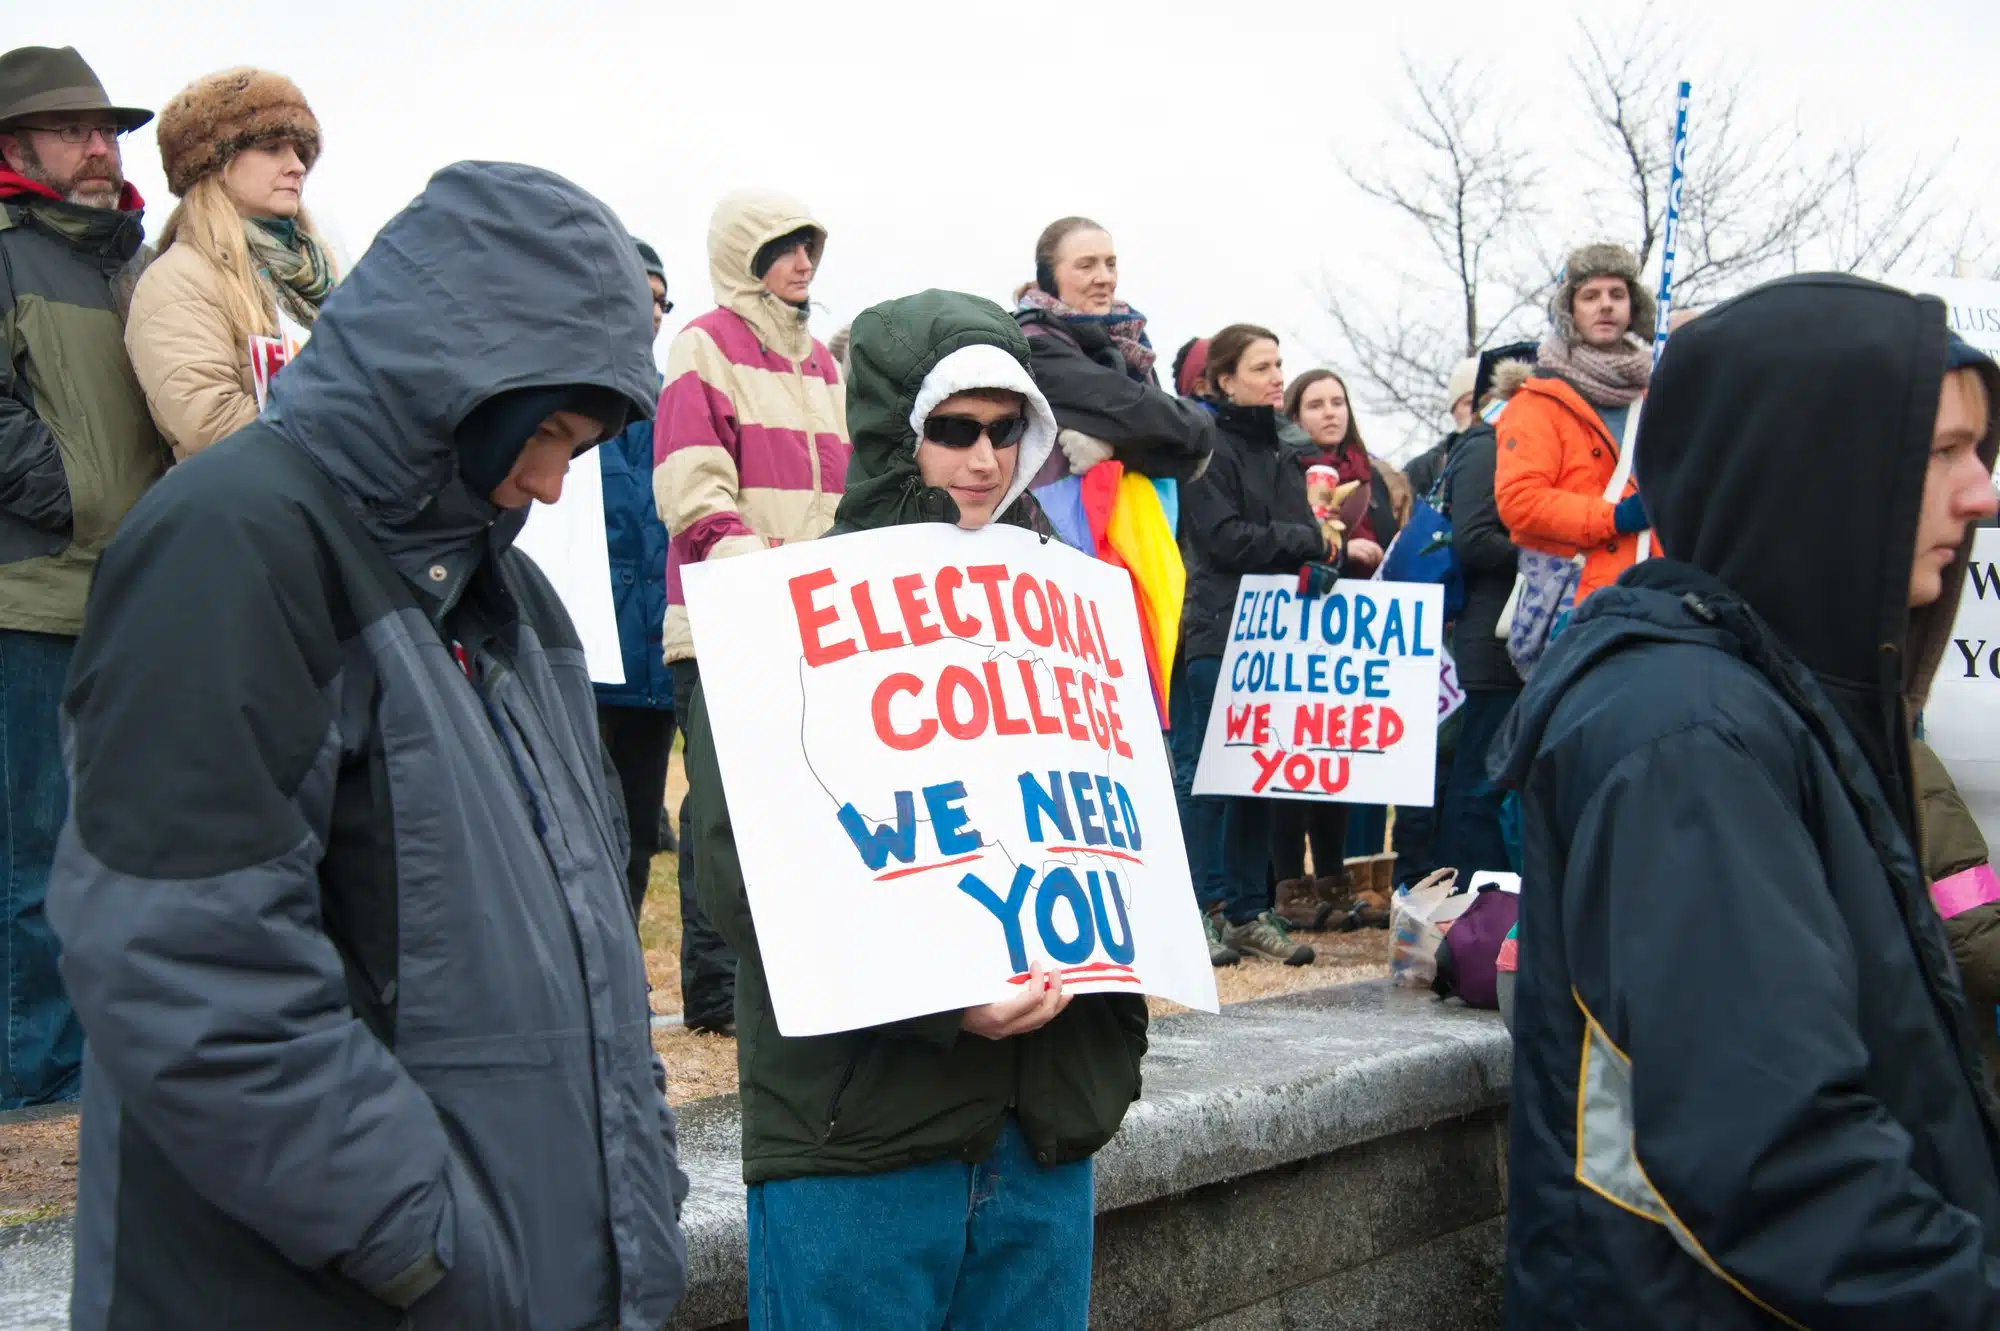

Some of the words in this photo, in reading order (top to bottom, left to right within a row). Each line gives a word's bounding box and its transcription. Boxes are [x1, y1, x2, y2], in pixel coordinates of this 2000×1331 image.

[788, 564, 1124, 678] ELECTORAL
[1233, 588, 1435, 657] ELECTORAL
[871, 659, 1133, 759] COLLEGE
[1232, 650, 1391, 699] COLLEGE
[1226, 703, 1272, 746] WE
[1293, 702, 1405, 750] NEED
[1251, 749, 1350, 794] YOU
[837, 780, 985, 870] WE
[1018, 771, 1141, 852] NEED
[957, 863, 1135, 973] YOU
